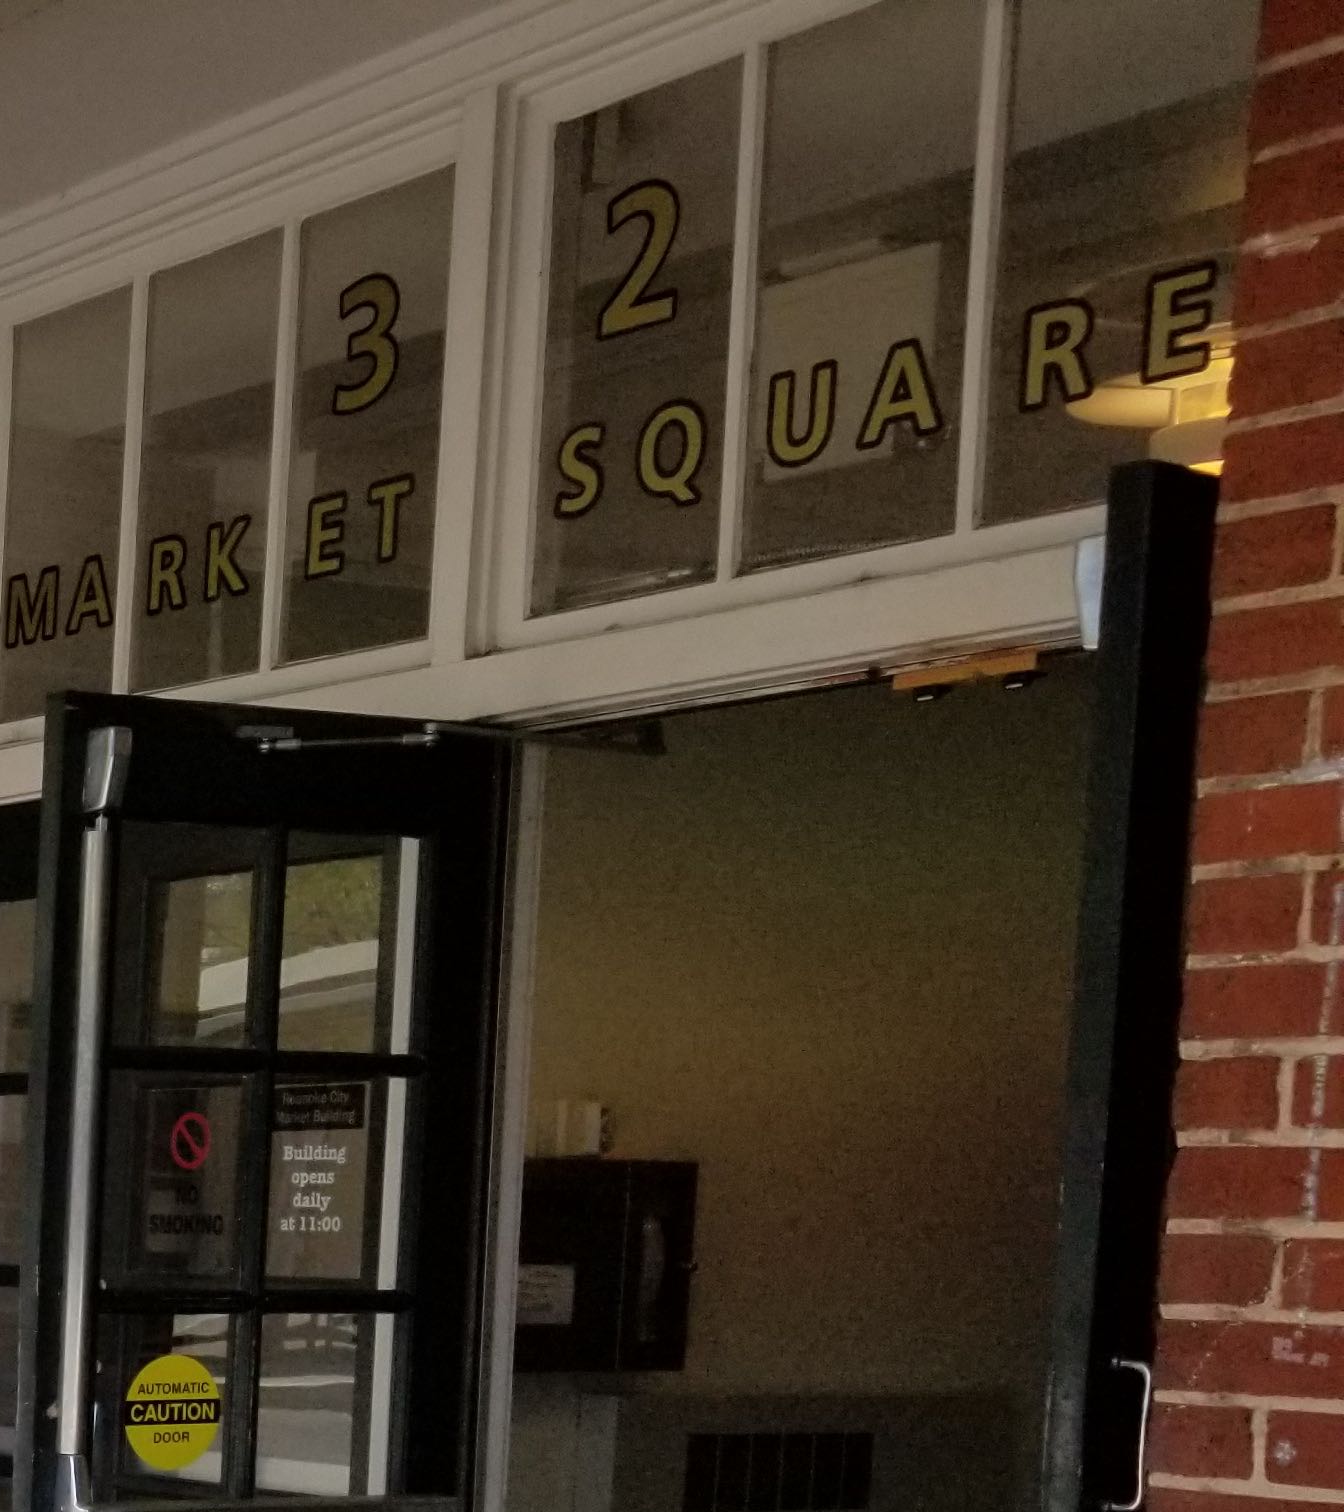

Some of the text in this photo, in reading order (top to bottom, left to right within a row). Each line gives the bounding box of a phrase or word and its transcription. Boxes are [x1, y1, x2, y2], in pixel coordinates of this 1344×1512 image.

[4, 259, 1217, 649] MARKET SQUARE
[283, 1145, 346, 1164] Building
[291, 1170, 335, 1188] opens
[293, 1193, 331, 1211] daily
[280, 1216, 341, 1232] at 11:00
[137, 1381, 210, 1395] AUTOMATIC
[130, 1402, 215, 1422] CAUTION
[153, 1430, 190, 1444] DOOR
